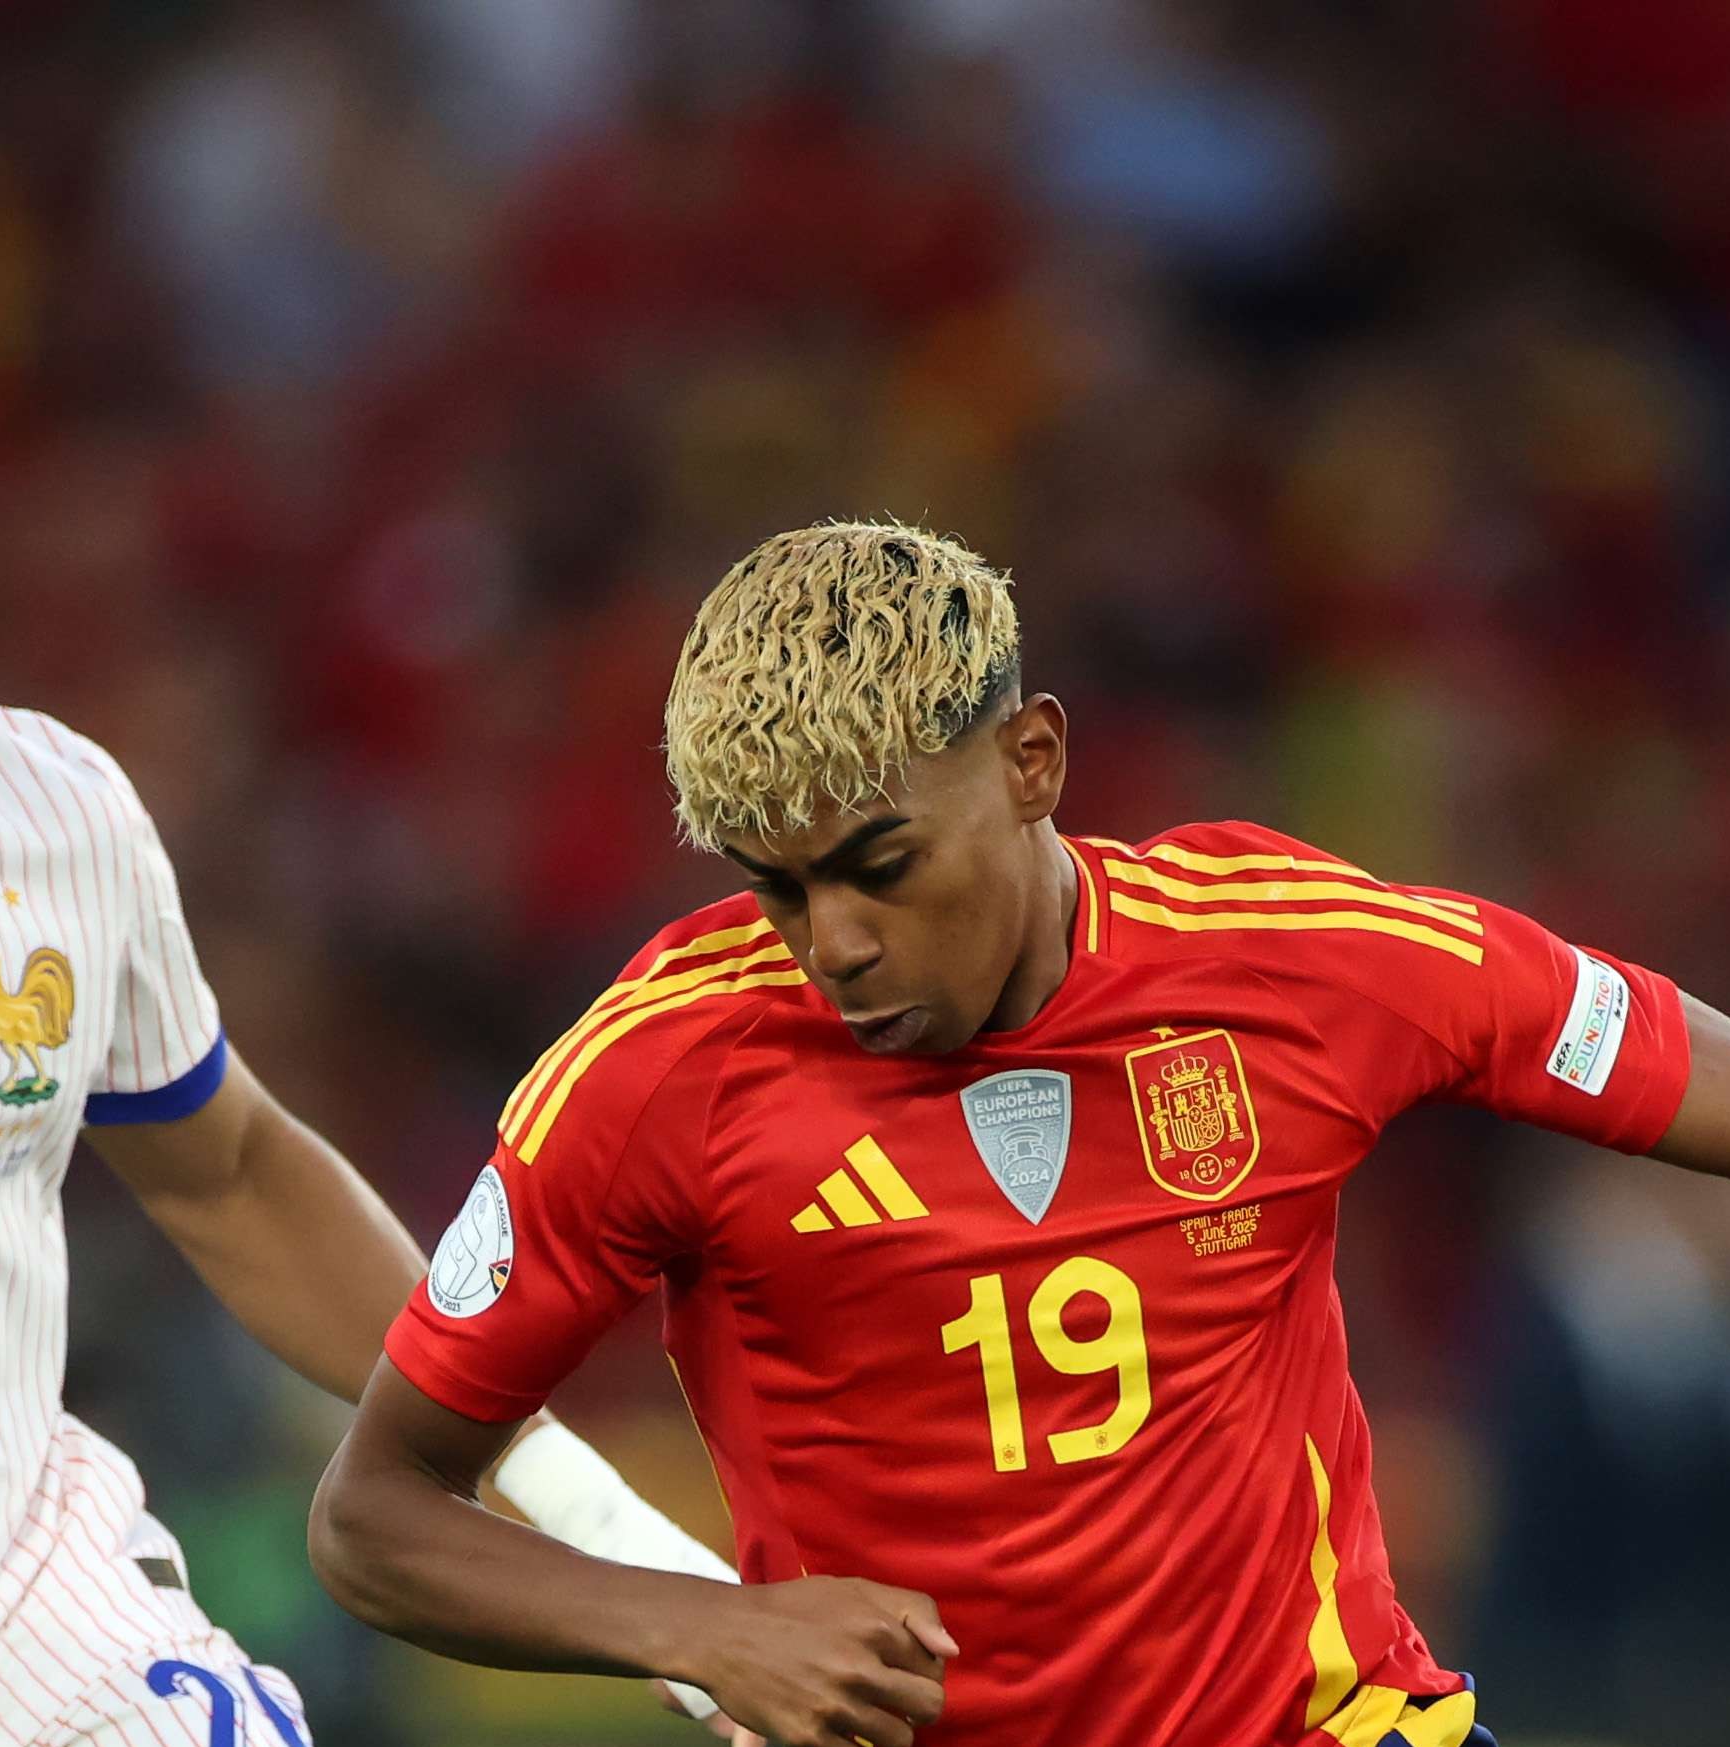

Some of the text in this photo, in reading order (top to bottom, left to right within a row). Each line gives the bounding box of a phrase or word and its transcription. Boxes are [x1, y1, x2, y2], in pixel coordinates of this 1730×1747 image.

[1553, 1042, 1572, 1074] UEFA
[997, 1080, 1032, 1094] UEFA
[973, 1088, 1060, 1114] EUROPEAN
[976, 1103, 1062, 1128] CHAMPIONS
[1008, 1168, 1051, 1188] 2024
[1179, 1215, 1211, 1233] SPAIN
[1221, 1204, 1262, 1225] FRANCE
[1186, 1218, 1257, 1245] 5 JUNE 2025
[1194, 1232, 1254, 1257] STUTTGART
[941, 1256, 1152, 1472] 19
